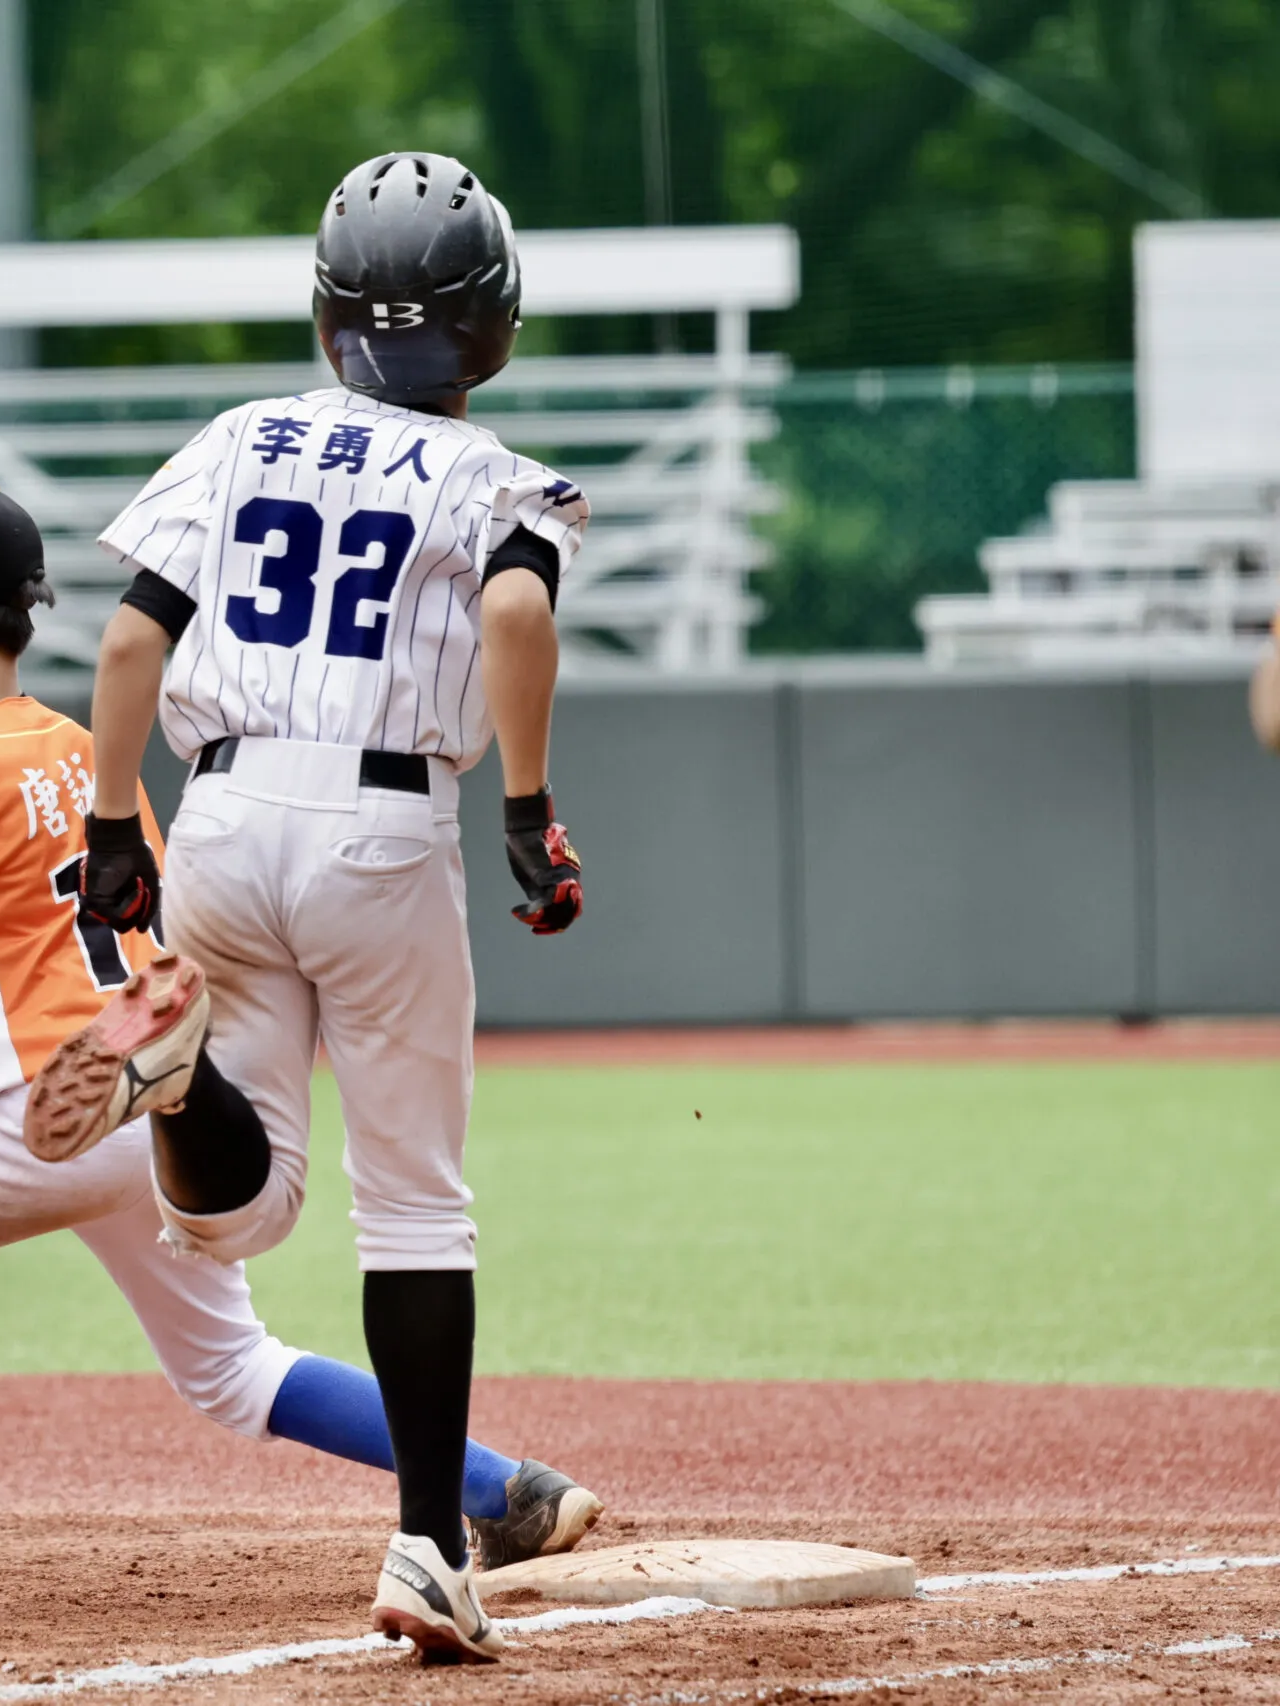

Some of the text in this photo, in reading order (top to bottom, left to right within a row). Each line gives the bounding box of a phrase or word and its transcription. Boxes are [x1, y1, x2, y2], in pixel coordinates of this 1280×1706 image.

[251, 417, 432, 484] 李勇人
[224, 496, 416, 661] 32
